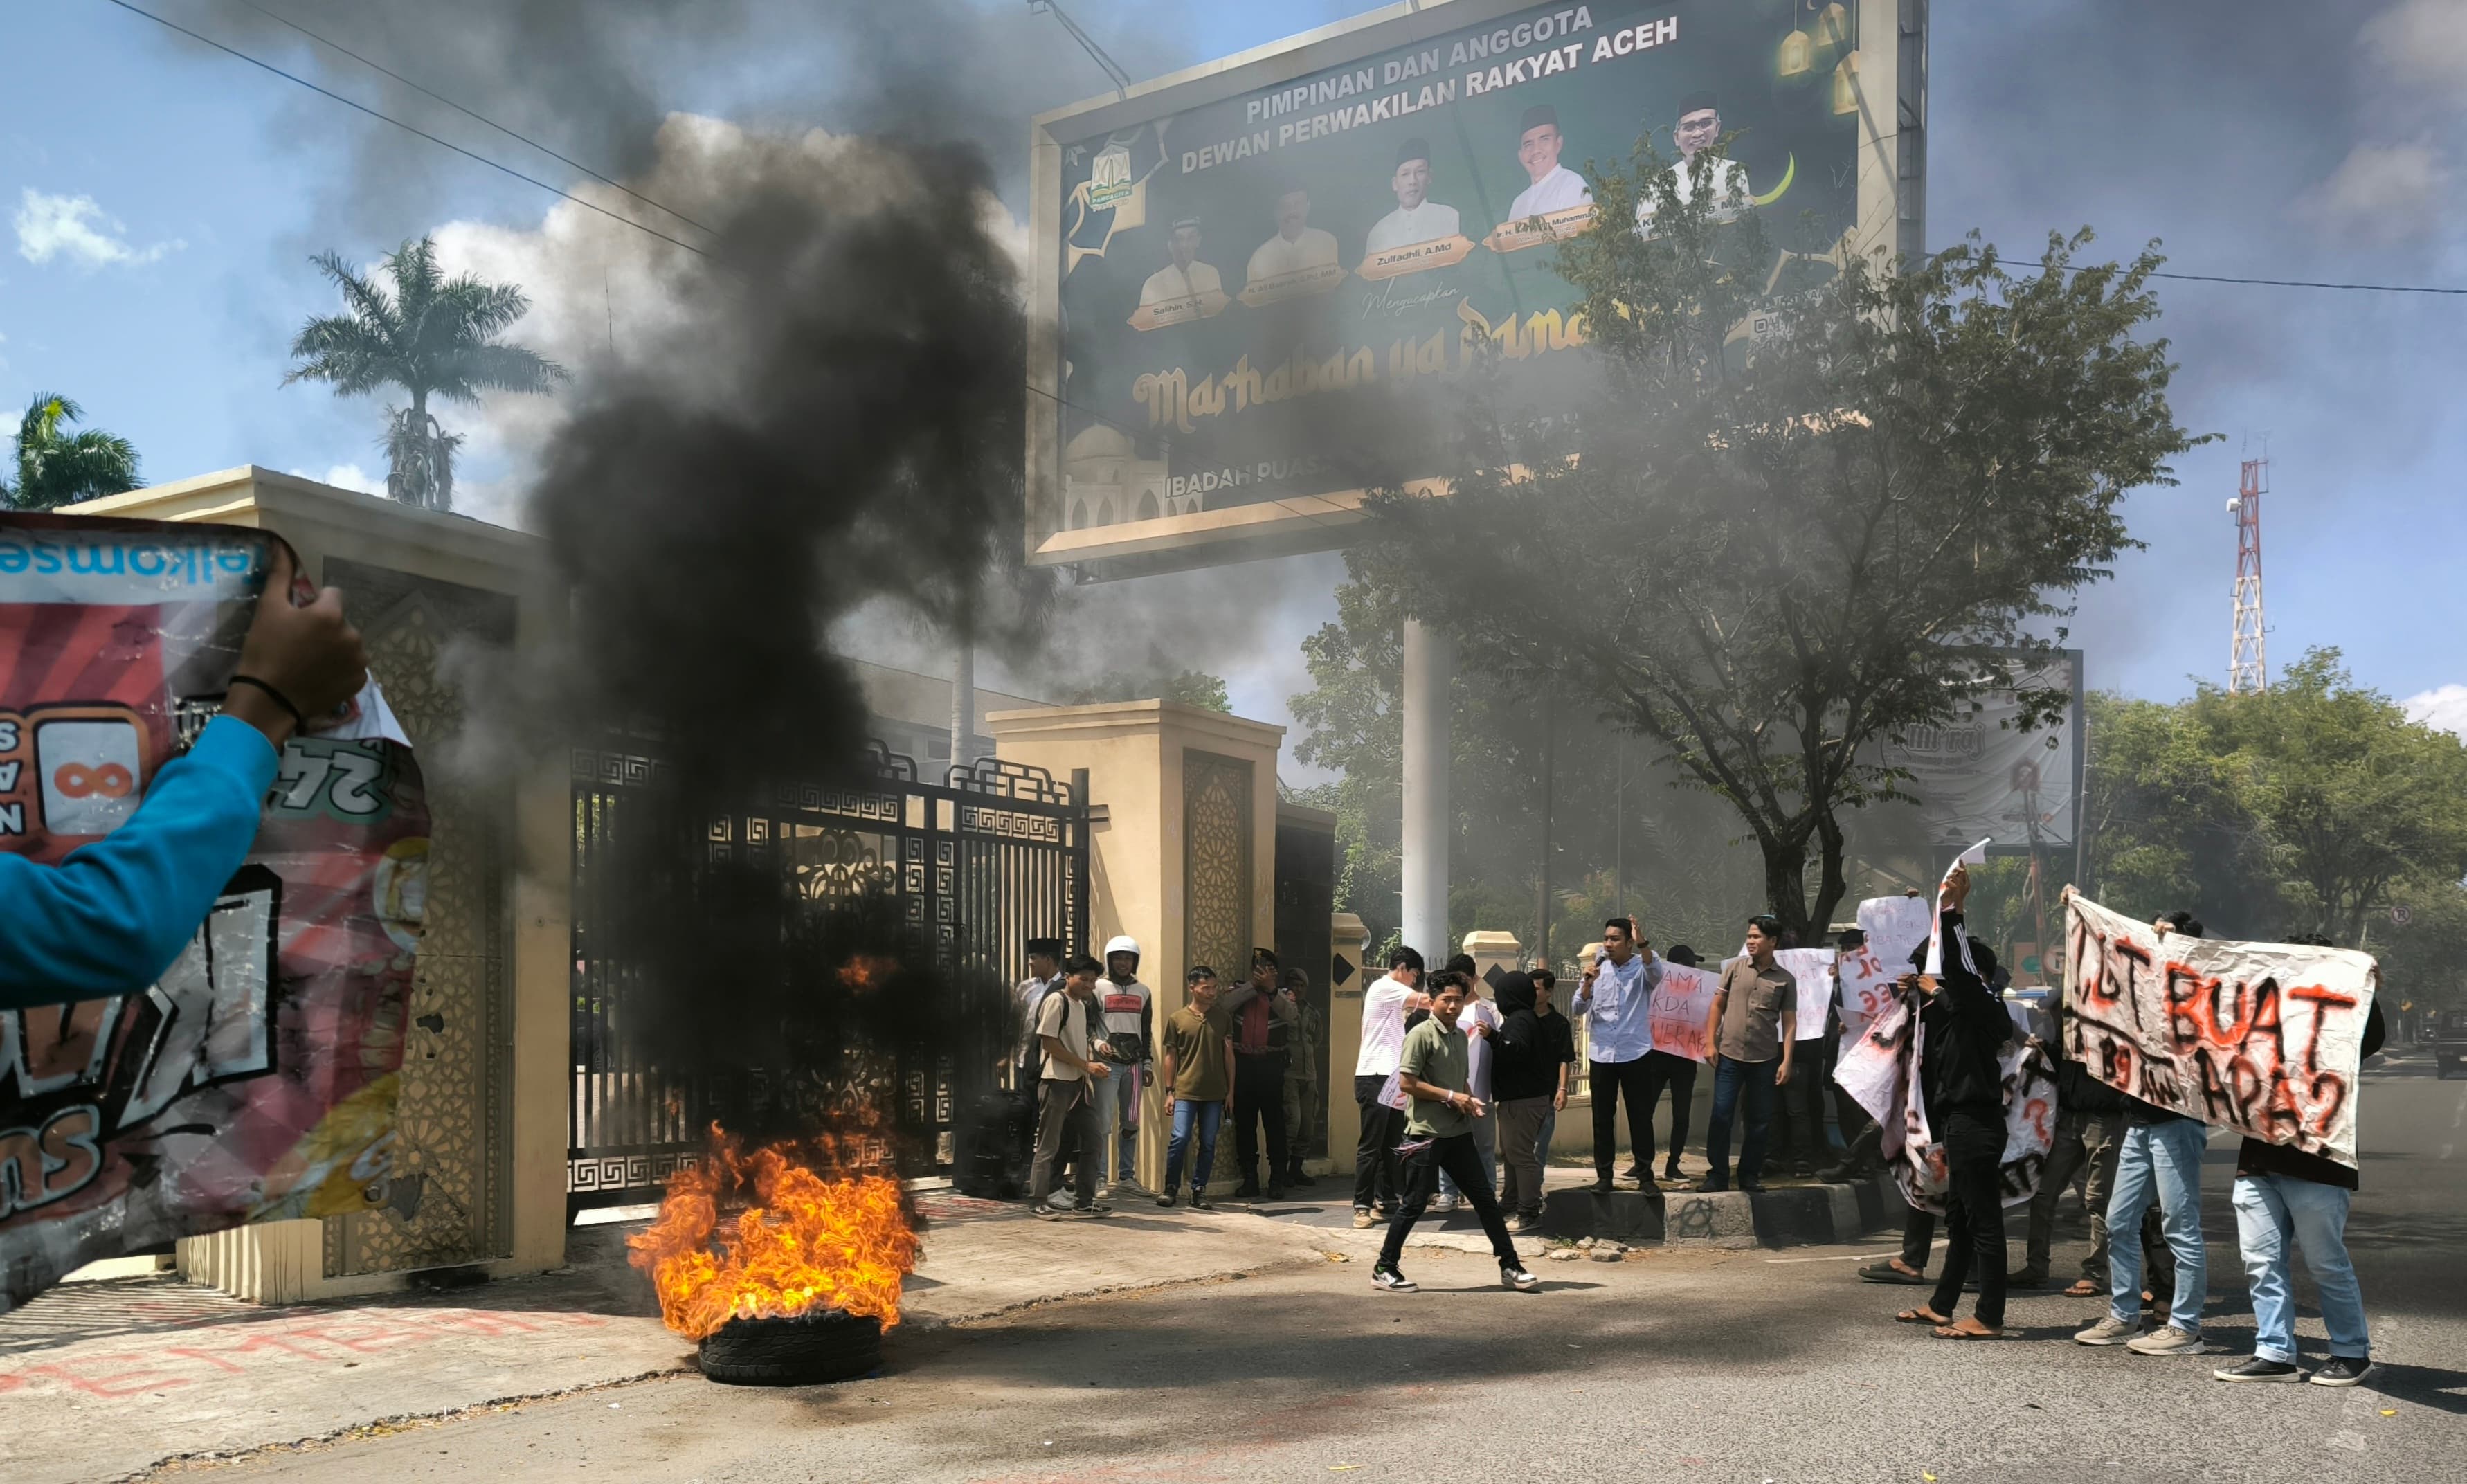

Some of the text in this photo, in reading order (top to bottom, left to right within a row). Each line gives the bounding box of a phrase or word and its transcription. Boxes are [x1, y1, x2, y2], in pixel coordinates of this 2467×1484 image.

[1182, 16, 1677, 174] DEWAN PERWAKILAN RAKYAT ACEH
[1247, 6, 1593, 124] PIMPINAN DAN ANGGOTA
[1362, 277, 1459, 320] Mengucapkan
[1132, 343, 1375, 434] Marhaban
[1165, 463, 1251, 498] IBADAH
[2164, 961, 2358, 1075] BUAT
